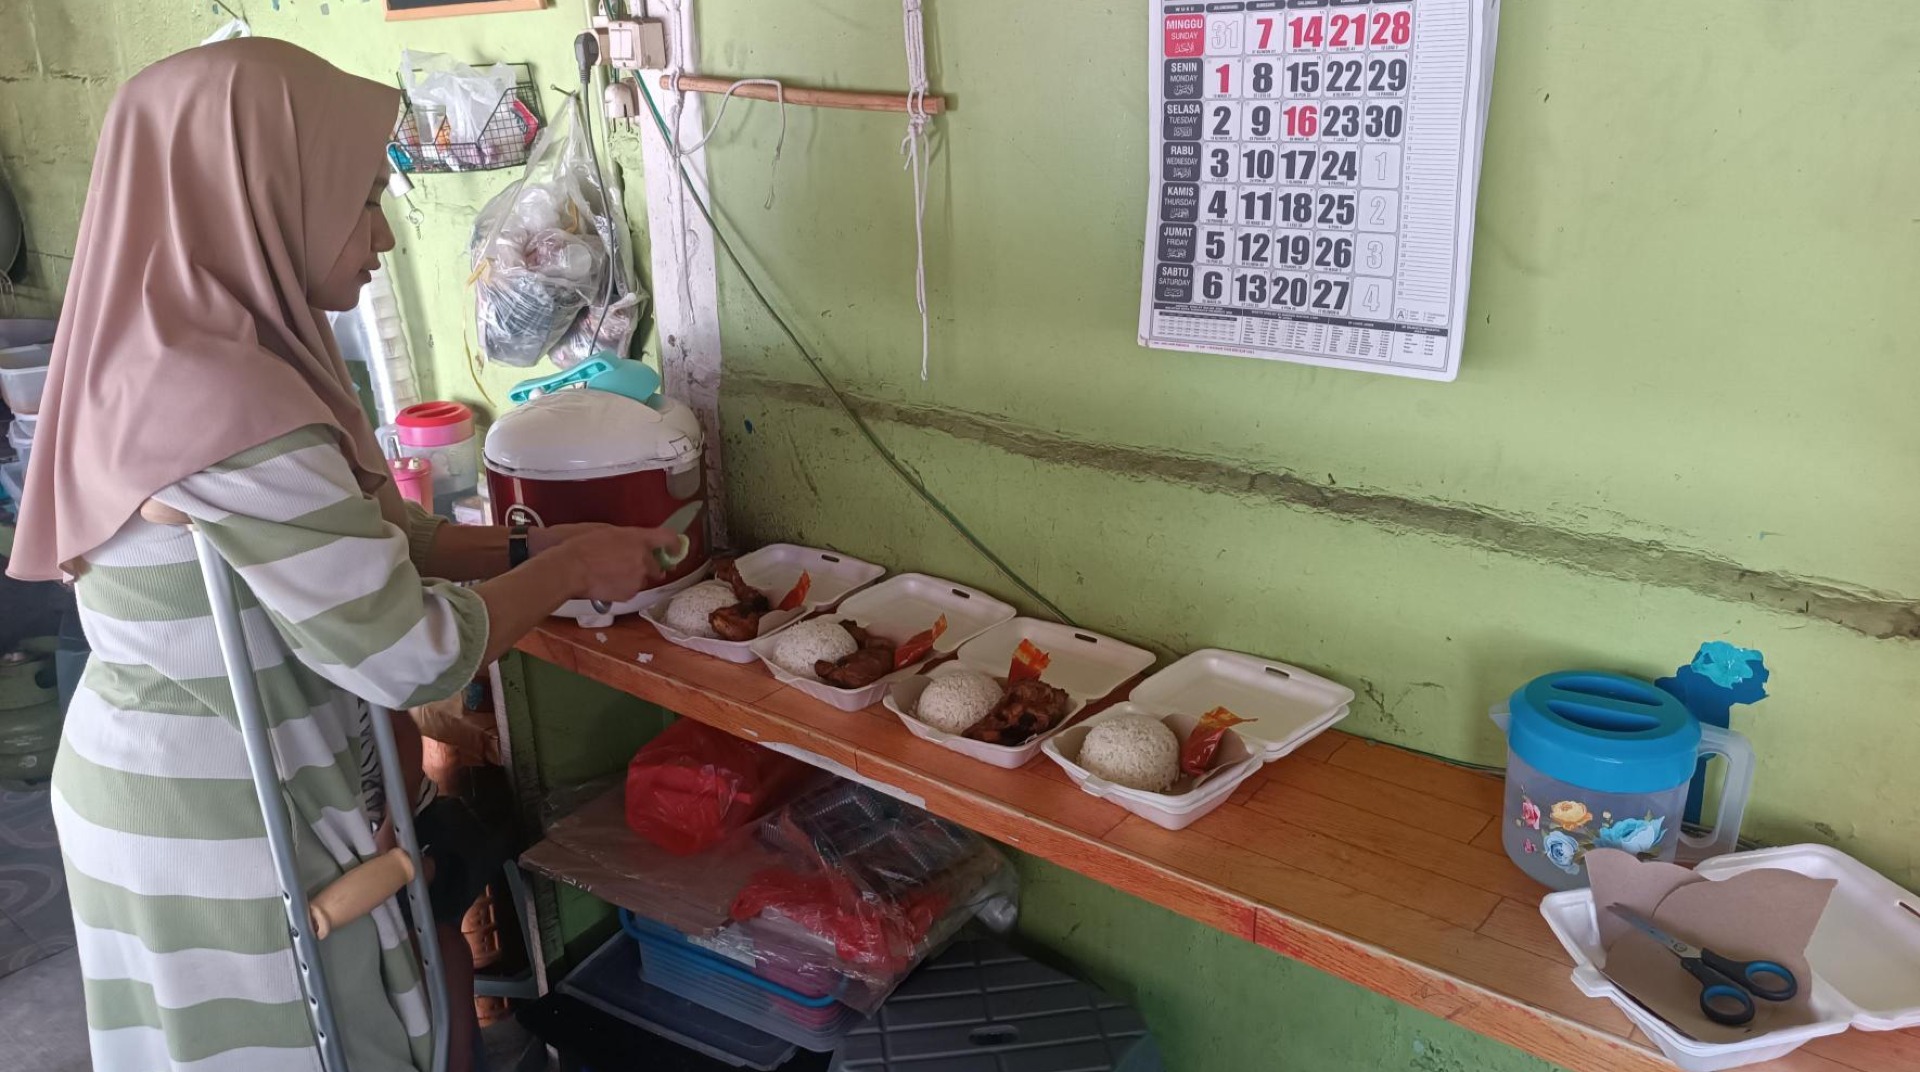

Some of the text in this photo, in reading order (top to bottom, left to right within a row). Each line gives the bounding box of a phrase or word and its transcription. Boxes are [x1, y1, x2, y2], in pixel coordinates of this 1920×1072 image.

[1166, 19, 1203, 29] MINGGU
[1211, 12, 1410, 49] 31 7 14 21 28
[1171, 62, 1197, 72] SENIN
[1170, 74, 1198, 82] MONDAY
[1216, 59, 1406, 93] 1 8 15 22 29
[1167, 104, 1201, 114] SELASA
[1169, 116, 1198, 124] TUESDAY
[1213, 106, 1402, 137] 2 9 16 23 30
[1170, 145, 1194, 155] RABU
[1166, 157, 1198, 165] WEDNESDAY
[1211, 149, 1229, 177] 3
[1243, 150, 1274, 179] 10
[1281, 151, 1316, 179] 17
[1321, 151, 1356, 180] 24
[1375, 151, 1387, 180] 1
[1167, 186, 1194, 196] KAMIS
[1164, 198, 1196, 206] THURSDAY
[1208, 191, 1386, 225] 4 11 18 25 2
[1163, 227, 1193, 236] JUMAT
[1166, 238, 1188, 246] FRIDAY
[1206, 231, 1384, 269] 5 12 19 26 3
[1162, 266, 1189, 277] SABTU
[1158, 278, 1191, 286] SATURDAY
[1203, 271, 1223, 299] 6
[1235, 274, 1266, 303] 13
[1271, 277, 1307, 306] 20
[1312, 280, 1349, 310] 27
[1362, 284, 1380, 311] 4
